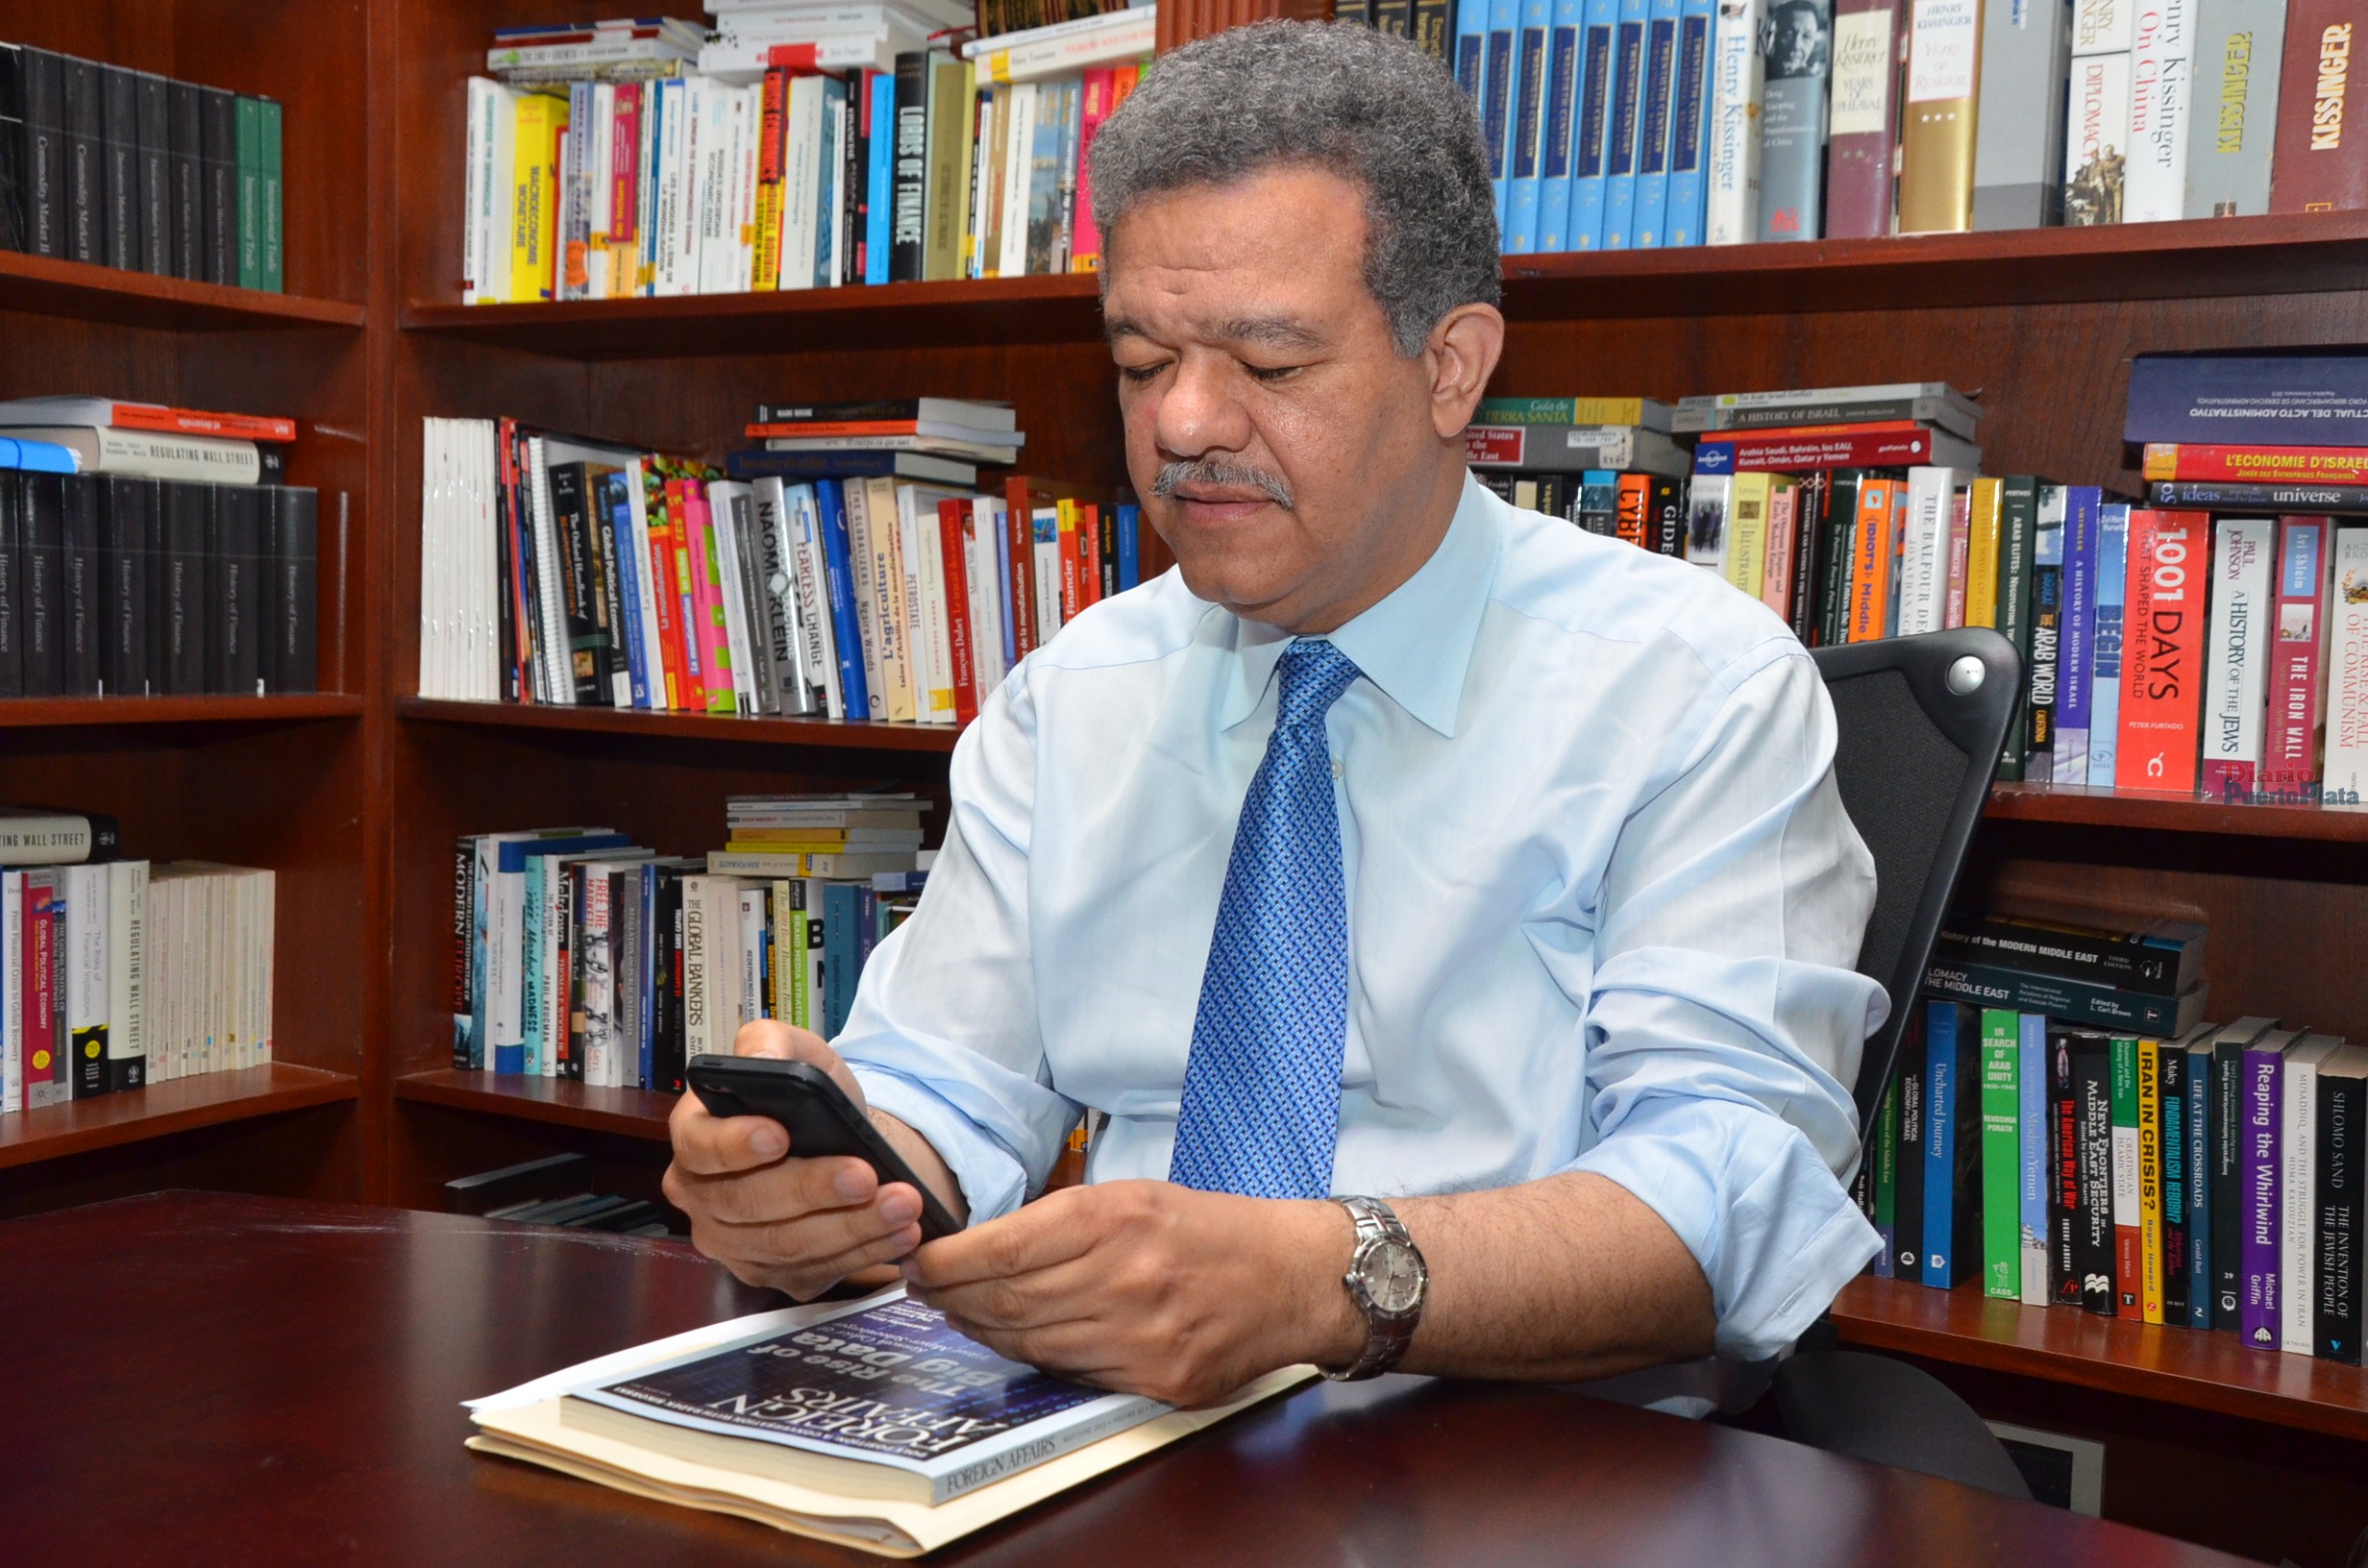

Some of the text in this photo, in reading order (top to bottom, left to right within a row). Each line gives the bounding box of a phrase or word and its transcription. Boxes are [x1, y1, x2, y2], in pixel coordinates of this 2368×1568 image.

[1916, 16, 1972, 29] KISSINGER
[1926, 3, 1962, 16] HENRY
[2132, 12, 2160, 134] On China
[2153, 0, 2186, 168] enry Kissinger
[2216, 32, 2253, 153] KISSINGER
[2310, 22, 2353, 151] KISSINGER
[2083, 64, 2104, 160] DIPLOMACY
[77, 144, 88, 259] Commodity Market II
[896, 106, 925, 245] LORDS OF FINANCE
[267, 180, 277, 272] International Trade
[516, 184, 527, 248] MONETAIRE
[1486, 411, 1567, 423] TIERRA SANTA
[1739, 408, 1840, 423] A HISTORY OF ISRAEL
[2183, 485, 2220, 502] ideas
[2226, 454, 2368, 469] L'ECONOMIE D'ISRAEL
[2273, 488, 2340, 502] universe
[1858, 523, 1877, 633] IDIOT'S Middle
[1918, 495, 1936, 601] THE BALFOUR
[2010, 517, 2023, 574] ARAB ELITES:
[2227, 528, 2242, 580] JOHNSON
[2242, 540, 2257, 567] PAUL
[2293, 533, 2308, 589] Avi Shlaim
[287, 565, 297, 653] History of Finance
[796, 541, 822, 668] FEARLESS CHANGE
[852, 490, 876, 673] THE GLOBALIZERS Ngaire Woods
[876, 553, 894, 660] L'agriculture
[906, 574, 921, 629] PETROSTATE
[1065, 558, 1074, 614] Financier
[2133, 527, 2155, 698] THAT SHAPED THE WORLD
[2148, 527, 2187, 700] 1001 DAYS
[955, 619, 969, 686] François Dubet
[2031, 614, 2058, 704] THE ARAB WORLD
[2095, 604, 2123, 678] BEGIN
[2219, 590, 2247, 752] A HISTORY OF THE JEWS
[2285, 656, 2308, 759] THE IRON WALL
[2339, 614, 2359, 748] OF COMMUNISM
[2129, 721, 2183, 730] PETER FURTADO
[12, 929, 20, 966] Financial
[455, 853, 467, 1014] MODERN EUROPE
[688, 899, 703, 1026] THE GLOBAL BANKERS
[12, 968, 20, 990] Crisis
[12, 1002, 20, 1025] Global
[128, 919, 140, 1050] REGULATING WALL STREET
[542, 975, 551, 995] PAUL
[1943, 979, 2010, 1000] MIDDLE EAST
[10, 1027, 19, 1062] Recovery
[1984, 1039, 2016, 1047] SEARCH
[1988, 1062, 2010, 1070] ARAB
[1994, 1027, 2006, 1036] IN
[1994, 1050, 2006, 1059] OF
[1987, 1072, 2011, 1081] UNITY
[2164, 1059, 2178, 1086] Maley
[1931, 1063, 1947, 1159] Uncharted Journey
[2141, 1051, 2156, 1211] IRAN IN CRISIS?
[2193, 1079, 2203, 1208] LIFE AT THE CROSSROADS
[2331, 1091, 2345, 1188] SHLOMO SAND
[2026, 1112, 2038, 1200] Modern Yemen
[2062, 1100, 2076, 1209] The American Way of War
[2164, 1096, 2182, 1223] FUNDAMENTALISM REBORN?
[2253, 1065, 2274, 1244] Reaping the Whirlwind
[2297, 1073, 2307, 1327] MUSADDIQ AND THE STRUGGLE FOR POWER IN IRAN
[2250, 1275, 2260, 1305] Griffin
[2264, 1273, 2275, 1309] Michael
[2323, 1205, 2335, 1315] THE JEWISH PEOPLE
[2336, 1206, 2350, 1318] THE INVENTION OF
[747, 1342, 970, 1398] The Rise of
[791, 1330, 1006, 1389] Big Data
[706, 1392, 968, 1453] FOREIGN
[773, 1384, 1009, 1432] AFFAIRS
[946, 1435, 1055, 1495] FOREIGN AFFAIRS
